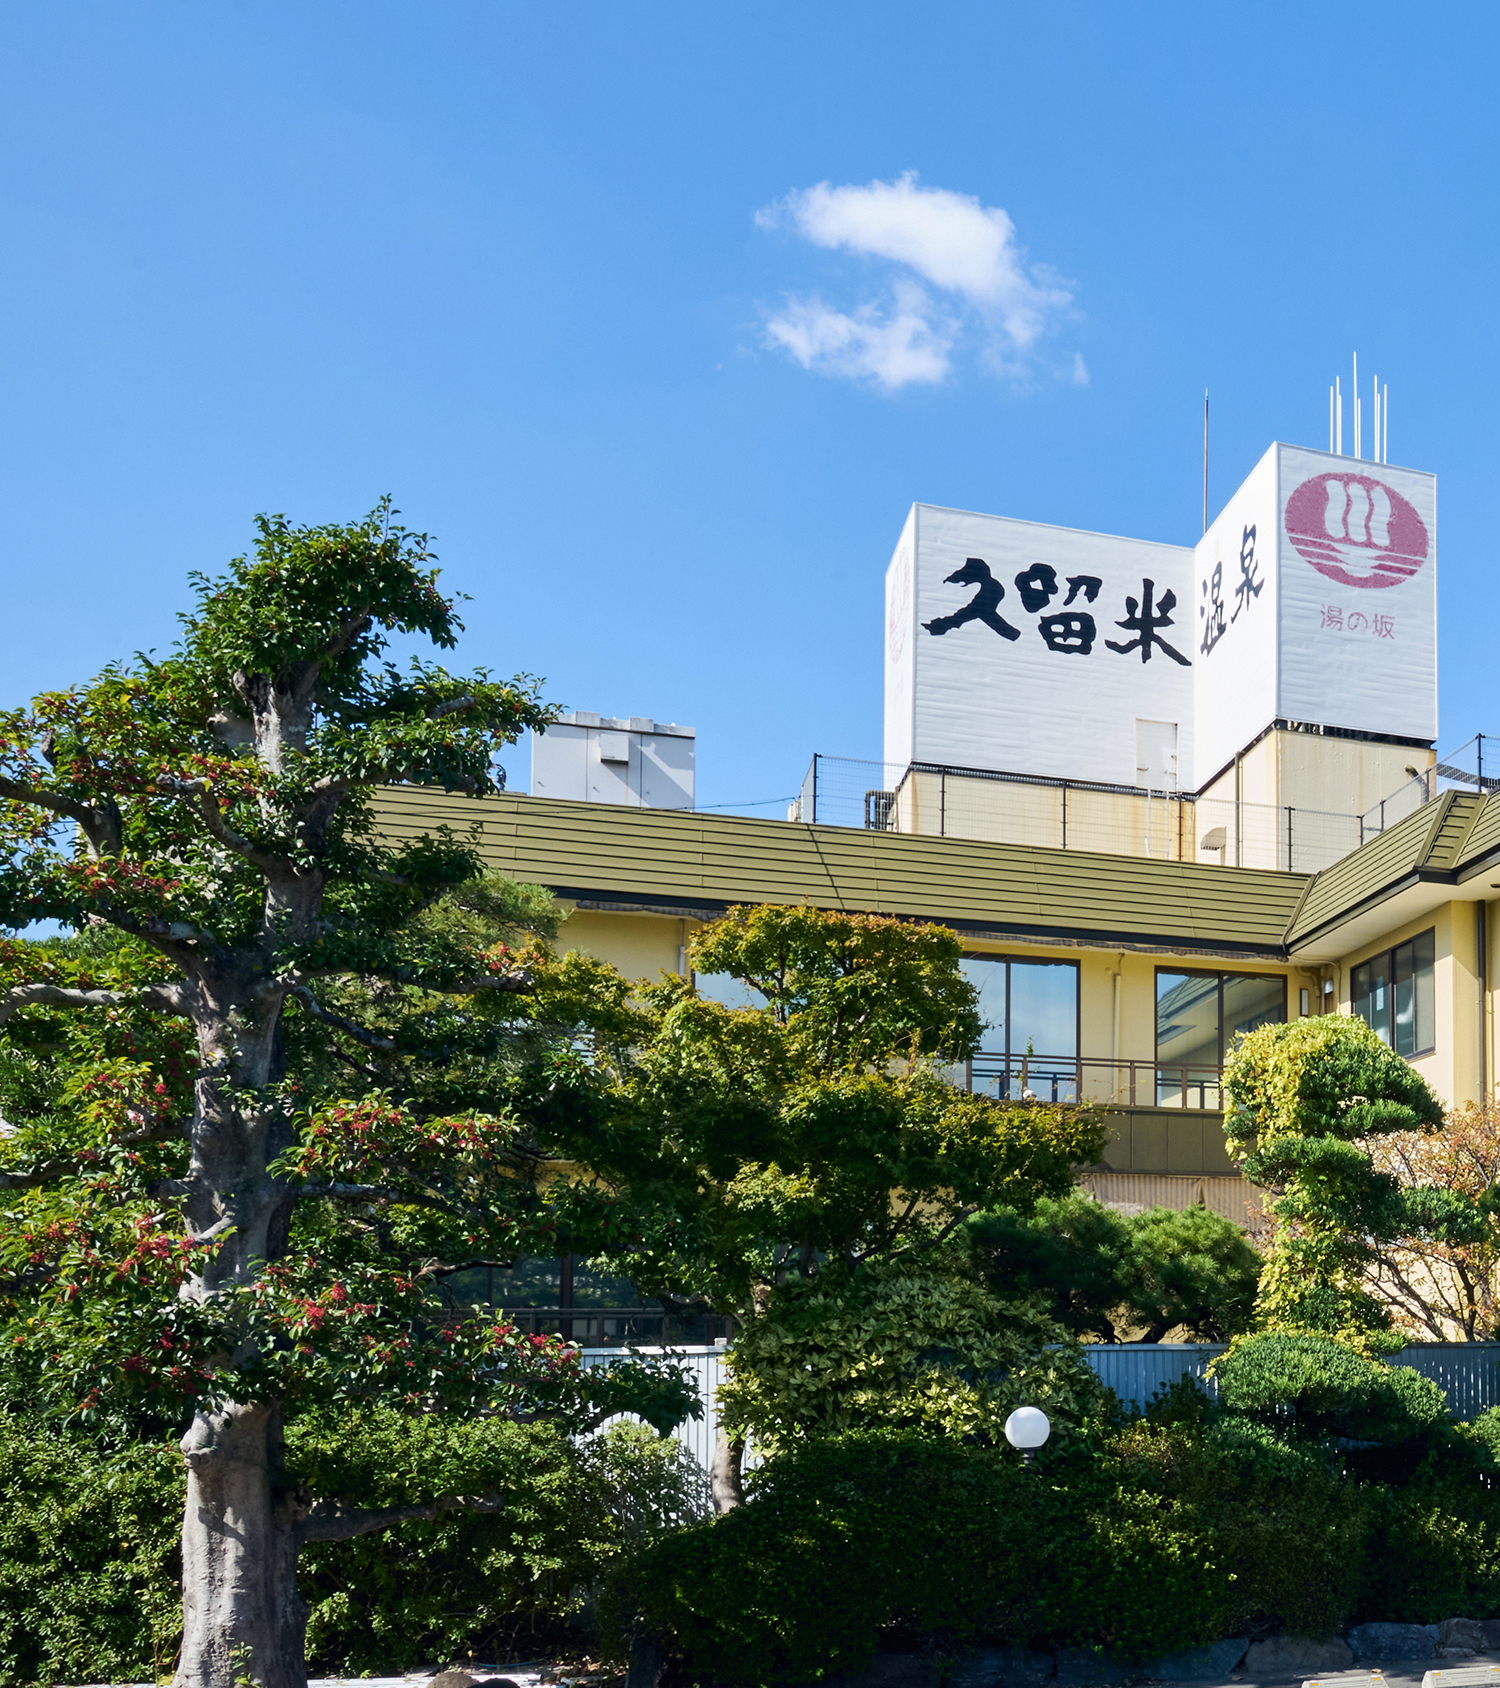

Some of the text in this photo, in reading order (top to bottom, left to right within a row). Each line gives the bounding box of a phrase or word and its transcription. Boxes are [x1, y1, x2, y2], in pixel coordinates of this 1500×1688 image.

[920, 557, 1192, 666] 久留米
[1200, 524, 1265, 658] 温泉
[1320, 604, 1395, 640] 湯の坂
